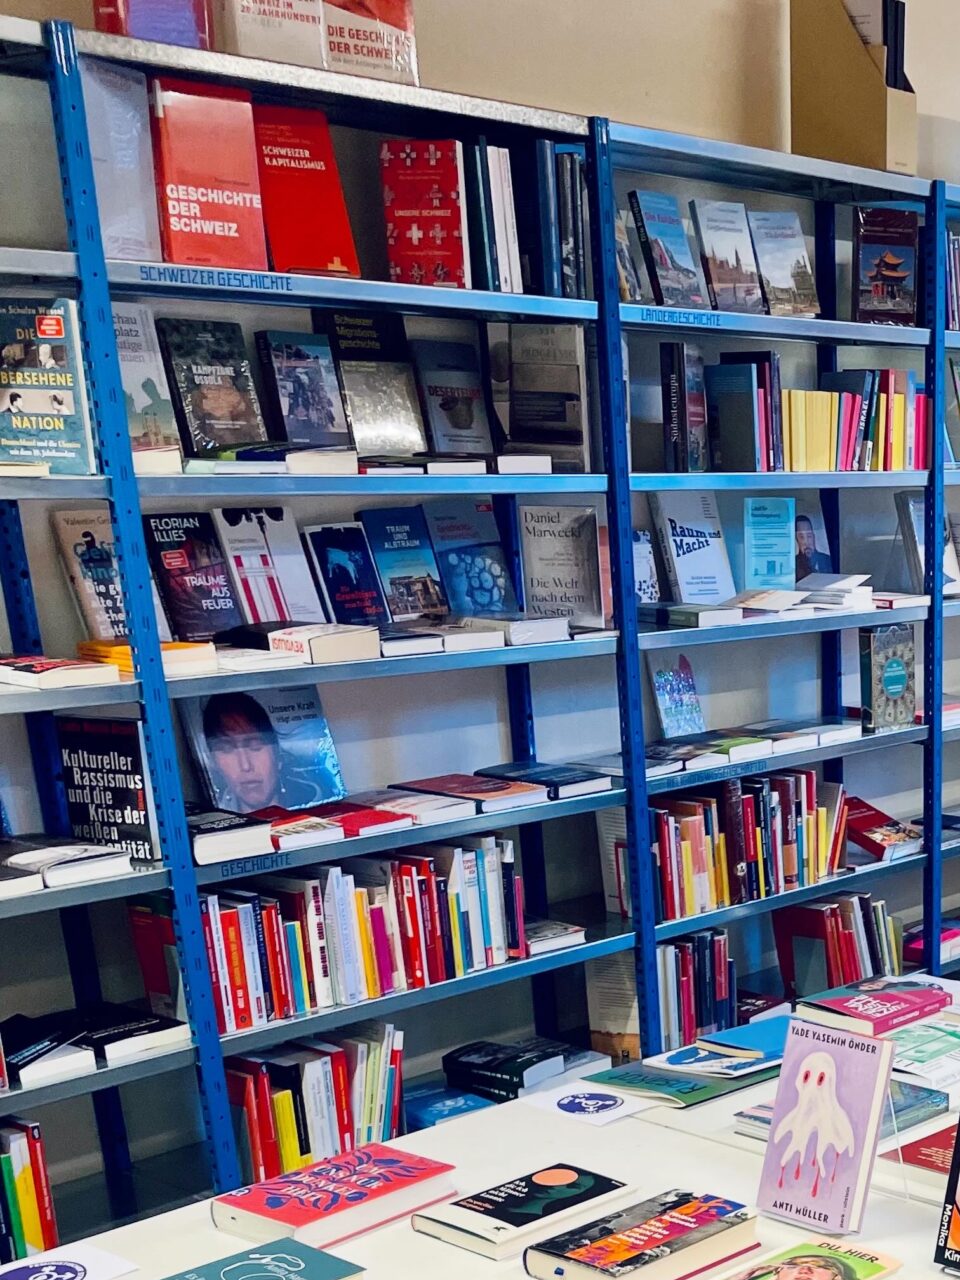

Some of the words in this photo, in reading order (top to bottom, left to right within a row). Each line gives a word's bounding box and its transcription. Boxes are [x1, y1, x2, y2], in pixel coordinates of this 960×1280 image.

[327, 25, 346, 39] DIE
[329, 40, 351, 54] DER
[262, 145, 310, 158] SCHWEIZER
[264, 157, 326, 171] KAPITALISMUS
[166, 184, 262, 209] GESCHICHTE
[168, 200, 201, 217] DER
[394, 209, 420, 218] UNSERE
[421, 209, 452, 218] SCHWEIZ
[170, 217, 239, 238] SCHWEIZ
[16, 328, 37, 341] DIE
[12, 415, 65, 430] NATION
[859, 400, 870, 431] ISRAEL
[150, 517, 200, 532] FLORIAN
[523, 511, 561, 525] Daniel
[385, 524, 411, 534] TRAUM
[668, 517, 708, 539] Raum
[707, 530, 722, 539] und
[154, 530, 187, 543] ILLIES
[673, 538, 711, 558] Macht
[184, 572, 228, 588] TRÄUME
[529, 577, 548, 588] Die
[550, 577, 579, 590] Welt
[211, 586, 231, 598] AUS
[531, 592, 559, 604] nach
[561, 591, 585, 604] dem
[201, 598, 234, 610] FEUER
[531, 604, 575, 617] Westen
[62, 748, 133, 772] Kultureller
[73, 768, 143, 790] Rassismus
[68, 788, 91, 805] und
[93, 787, 113, 806] die
[89, 805, 123, 823] Krise
[124, 806, 146, 826] der
[221, 852, 292, 878] GESCHICHTE
[791, 1026, 810, 1039] YADE
[812, 1032, 847, 1048] YASEMIN
[848, 1037, 878, 1055] ÖNDER
[773, 1200, 796, 1215] ANTI
[798, 1205, 829, 1224] MÜLLER
[937, 1204, 953, 1247] Monika
[818, 1241, 841, 1253] DU,
[843, 1248, 880, 1264] HIER
